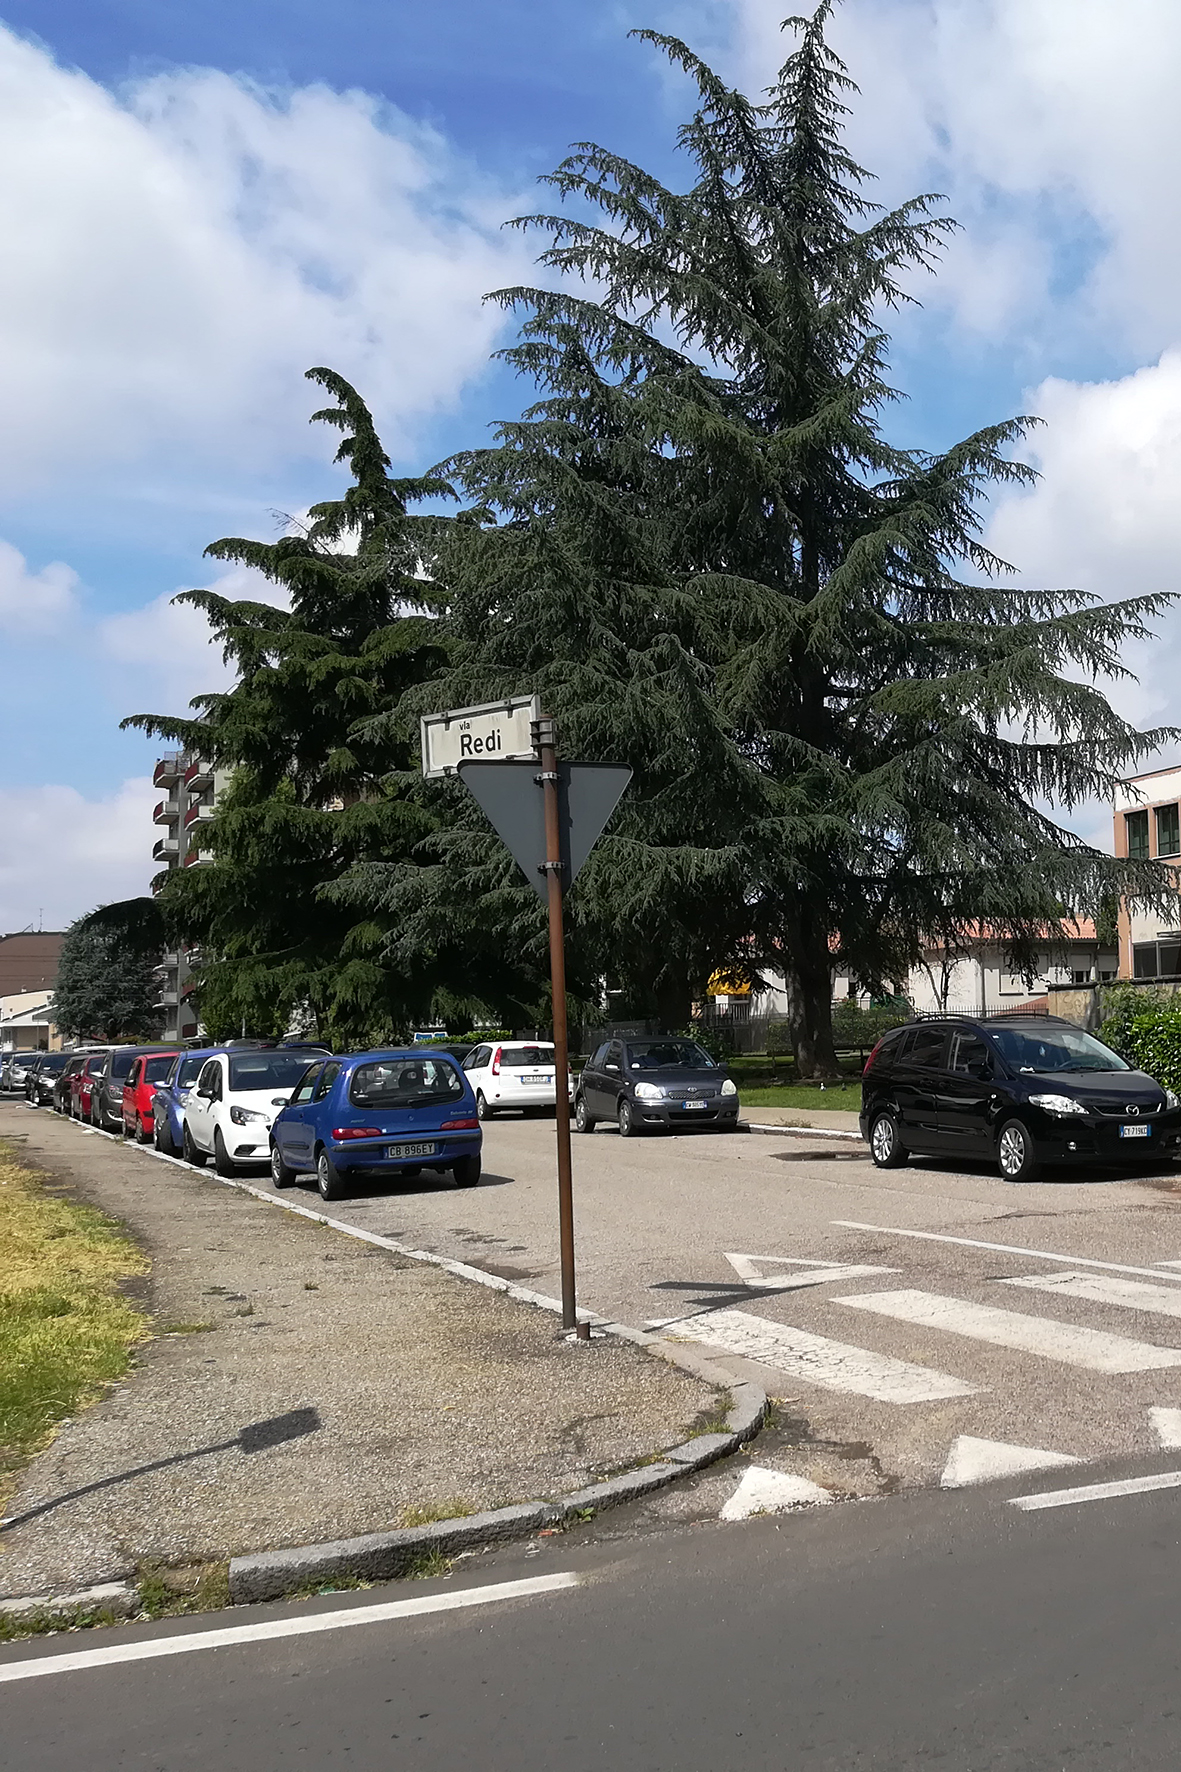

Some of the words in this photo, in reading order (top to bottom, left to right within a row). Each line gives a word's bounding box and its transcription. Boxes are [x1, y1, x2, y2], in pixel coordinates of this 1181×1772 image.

[459, 721, 471, 730] via
[460, 729, 501, 757] Redi
[390, 1146, 402, 1156] CB
[404, 1143, 433, 1155] 896EY
